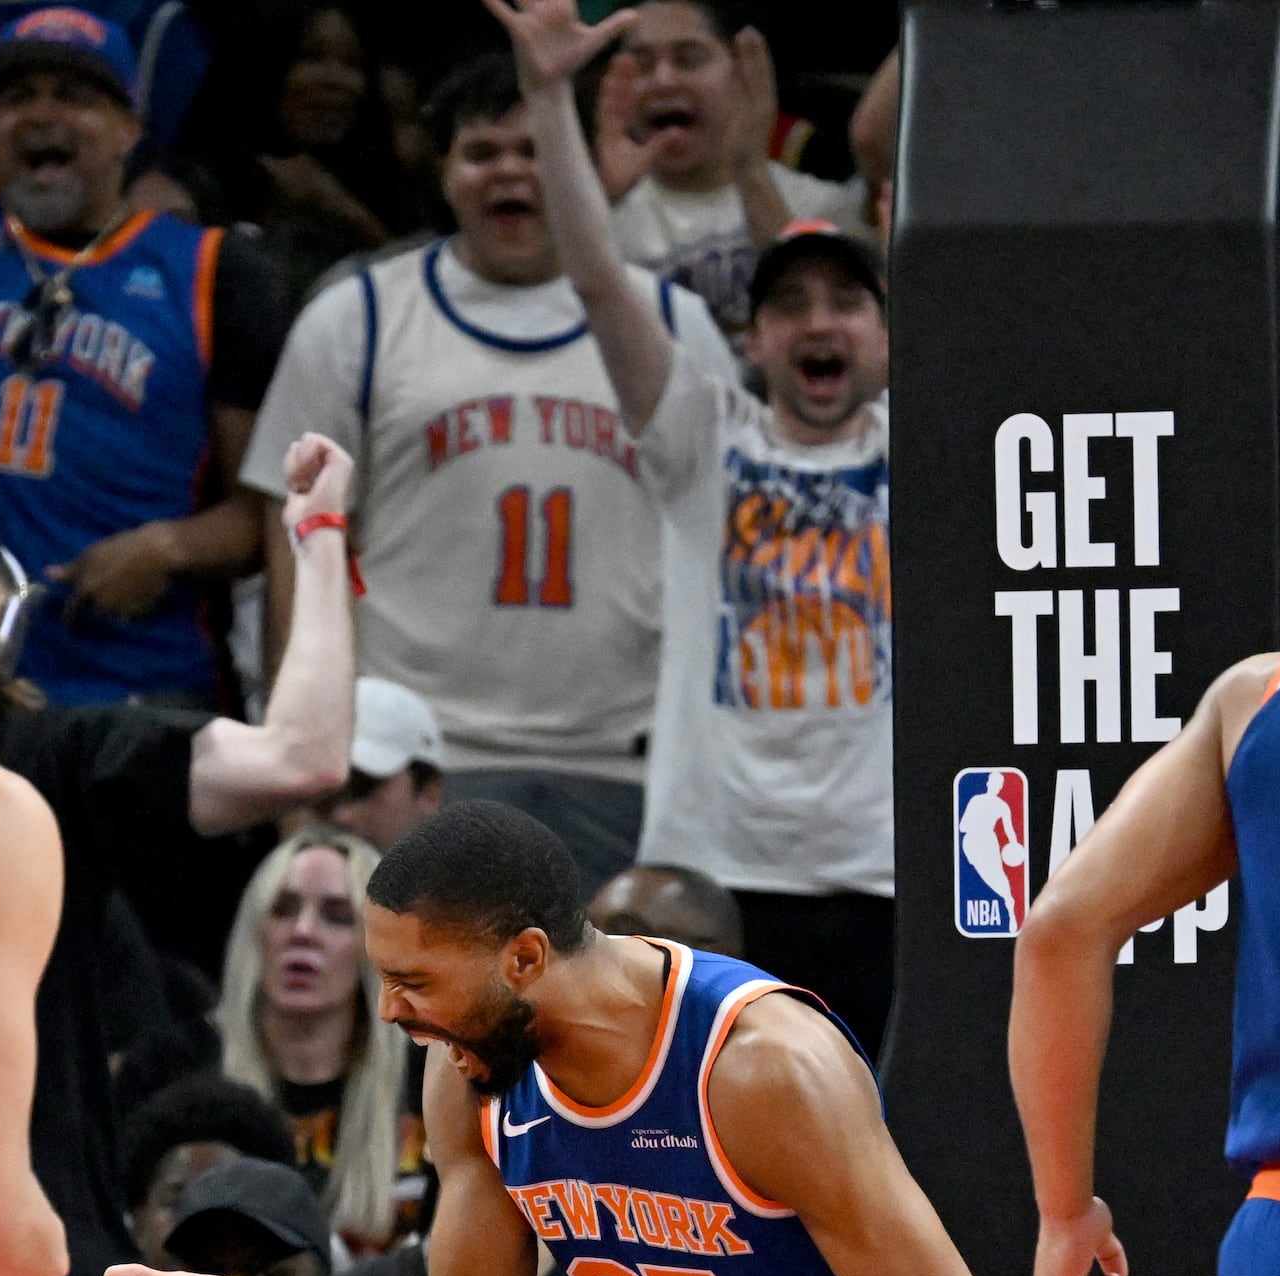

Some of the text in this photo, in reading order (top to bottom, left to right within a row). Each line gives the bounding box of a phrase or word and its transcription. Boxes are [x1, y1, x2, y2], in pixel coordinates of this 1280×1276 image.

[425, 396, 513, 472] NEW
[995, 411, 1175, 571] GET
[491, 484, 574, 608] 11
[995, 587, 1182, 745] THE
[966, 899, 1002, 927] NBA
[631, 1134, 699, 1149] abu dhabi
[594, 1182, 755, 1257] YORK
